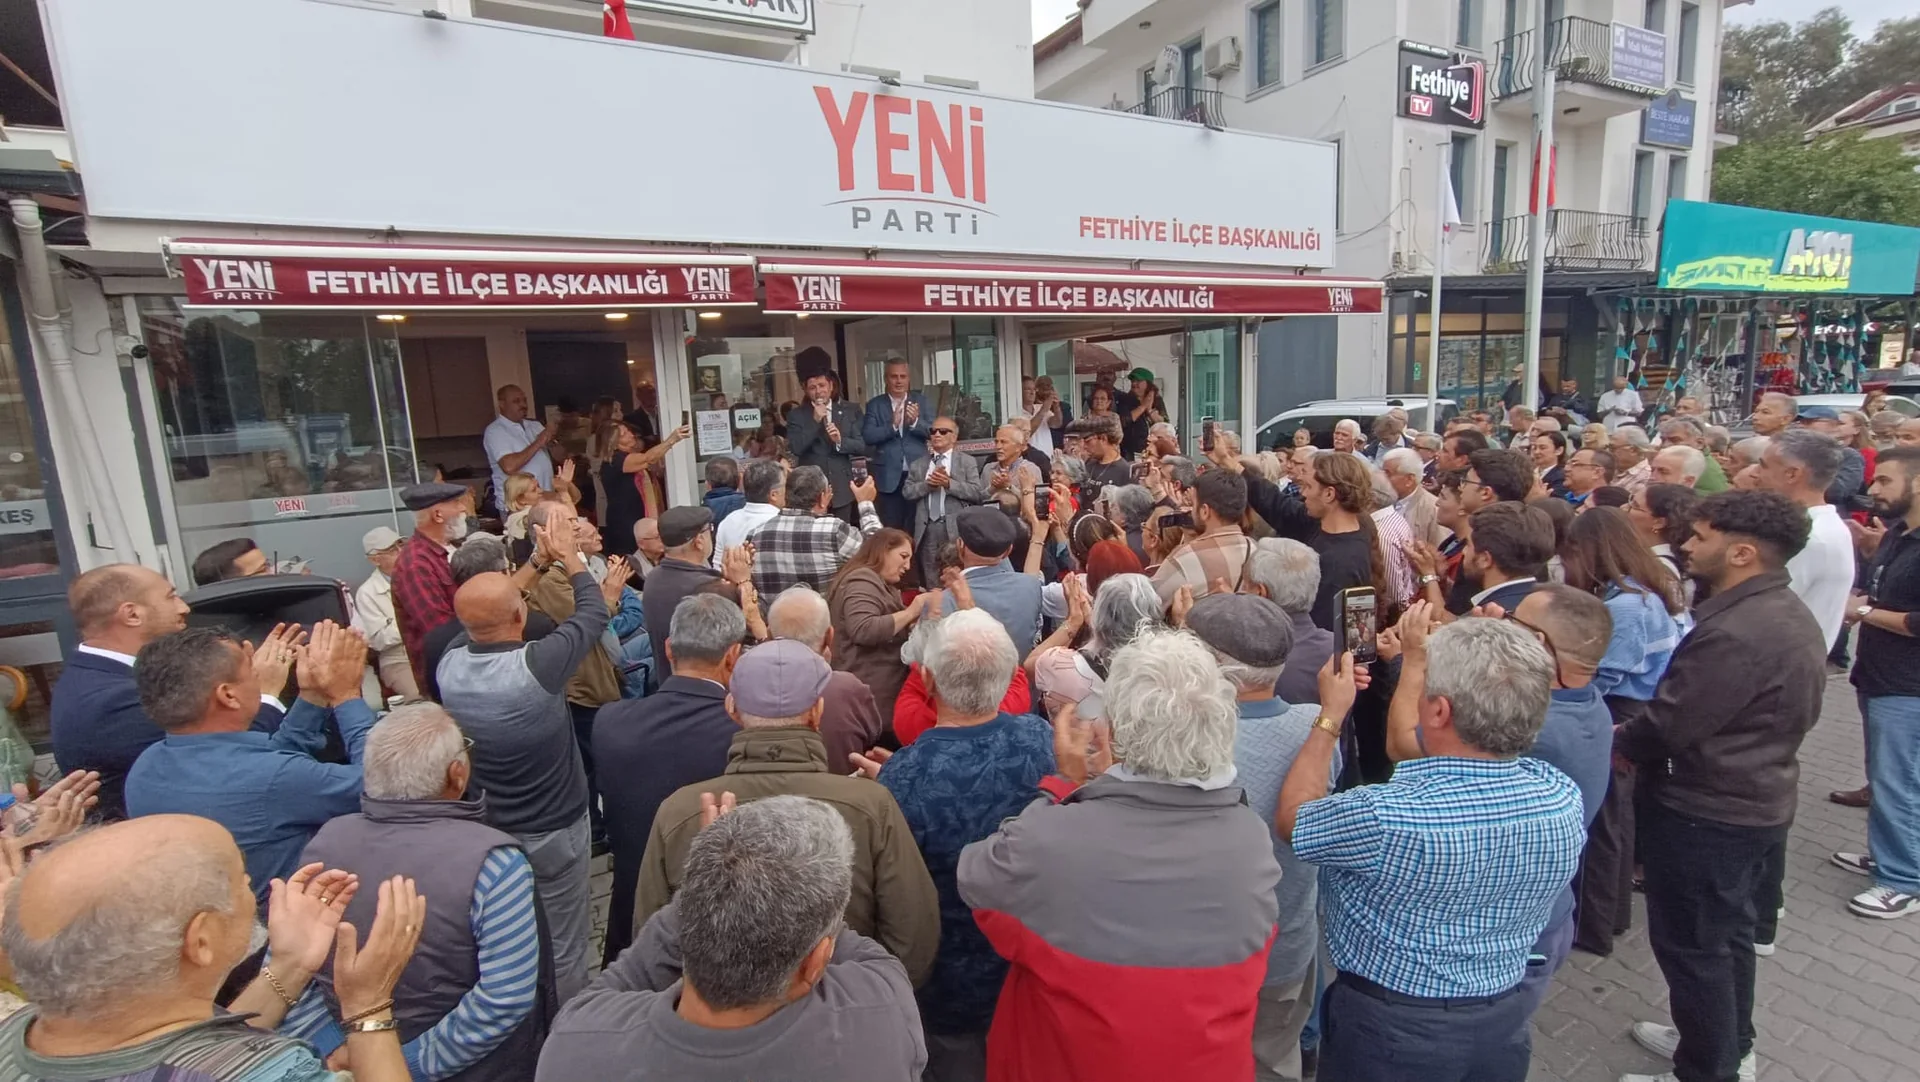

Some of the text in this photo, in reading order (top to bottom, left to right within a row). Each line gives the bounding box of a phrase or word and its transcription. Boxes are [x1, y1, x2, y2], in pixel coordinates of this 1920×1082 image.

[1411, 64, 1469, 105] Fethiye
[1412, 98, 1430, 112] TV
[1079, 215, 1321, 251] FETHİYE İLÇE BAŞKANLIĞI
[306, 265, 668, 299] FETHİYE İLÇE BAŞKANLIĞI
[924, 280, 1215, 311] FETHİYE İLÇE BAŞKANLIĞI
[738, 414, 759, 423] AÇIK
